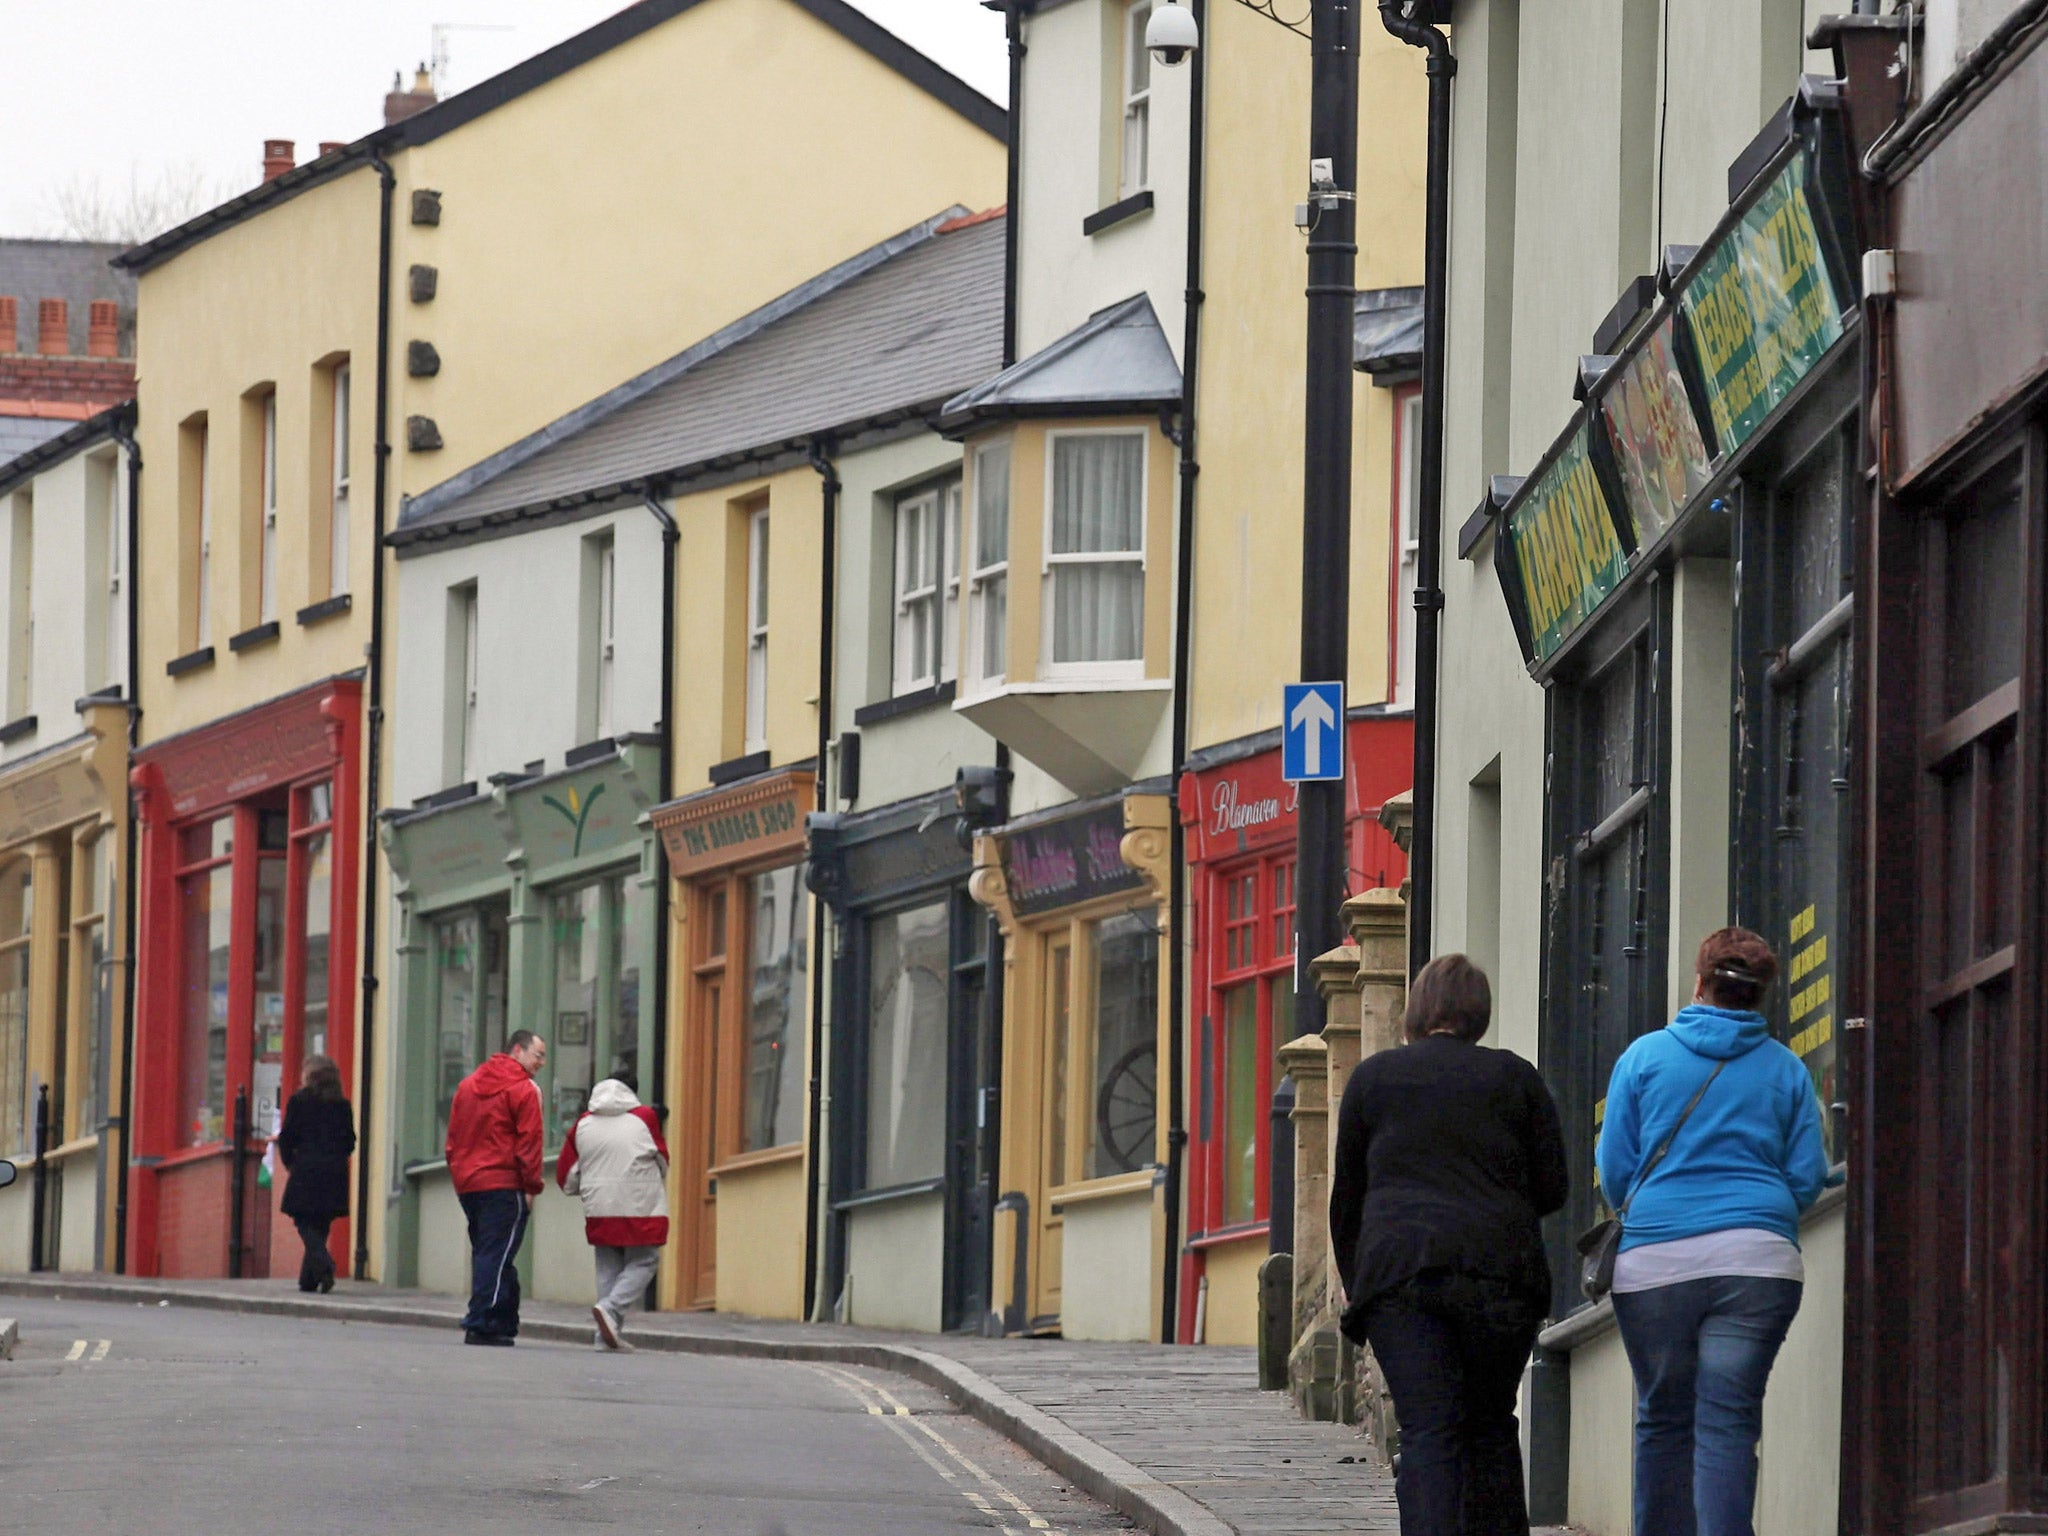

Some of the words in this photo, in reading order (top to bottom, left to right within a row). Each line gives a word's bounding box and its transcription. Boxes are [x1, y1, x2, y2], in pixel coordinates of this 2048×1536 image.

[1688, 258, 1753, 383] KEBABS
[1753, 183, 1818, 310] PIZZAS
[1516, 455, 1622, 642] KARAKAYA
[682, 824, 709, 856] THE
[708, 810, 760, 849] BARBER
[760, 799, 796, 836] SHOP
[1210, 779, 1278, 836] Blaenavon
